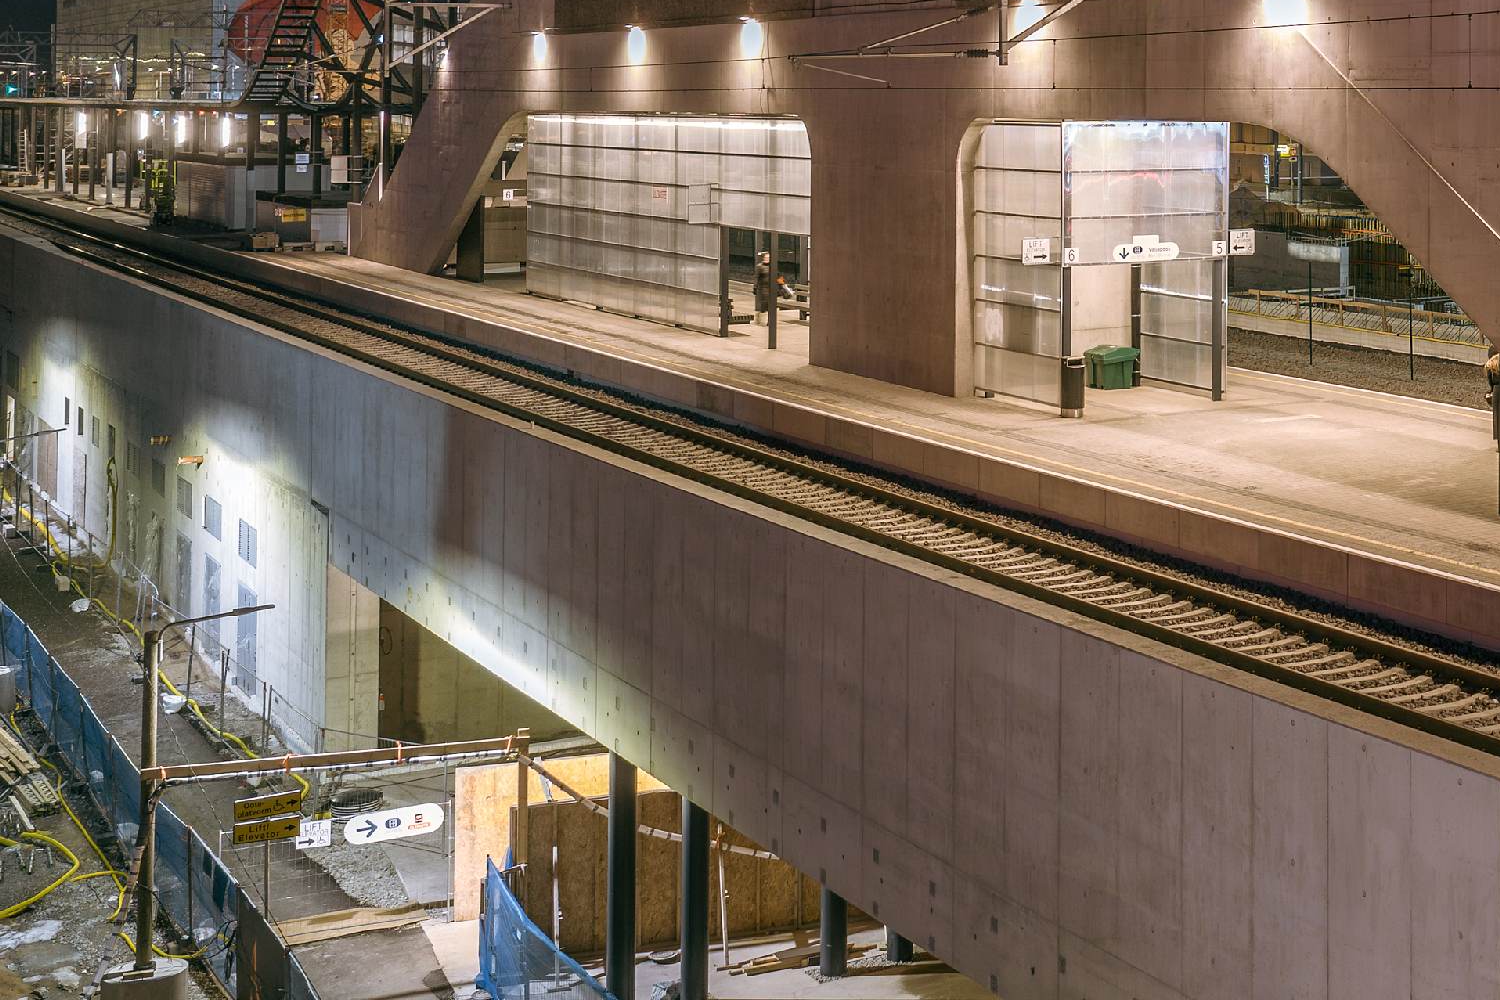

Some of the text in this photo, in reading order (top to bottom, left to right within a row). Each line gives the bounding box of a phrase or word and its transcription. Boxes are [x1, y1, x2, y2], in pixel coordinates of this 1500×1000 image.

[1216, 242, 1223, 255] 5
[1068, 249, 1076, 262] 6
[304, 822, 322, 832] LIFT
